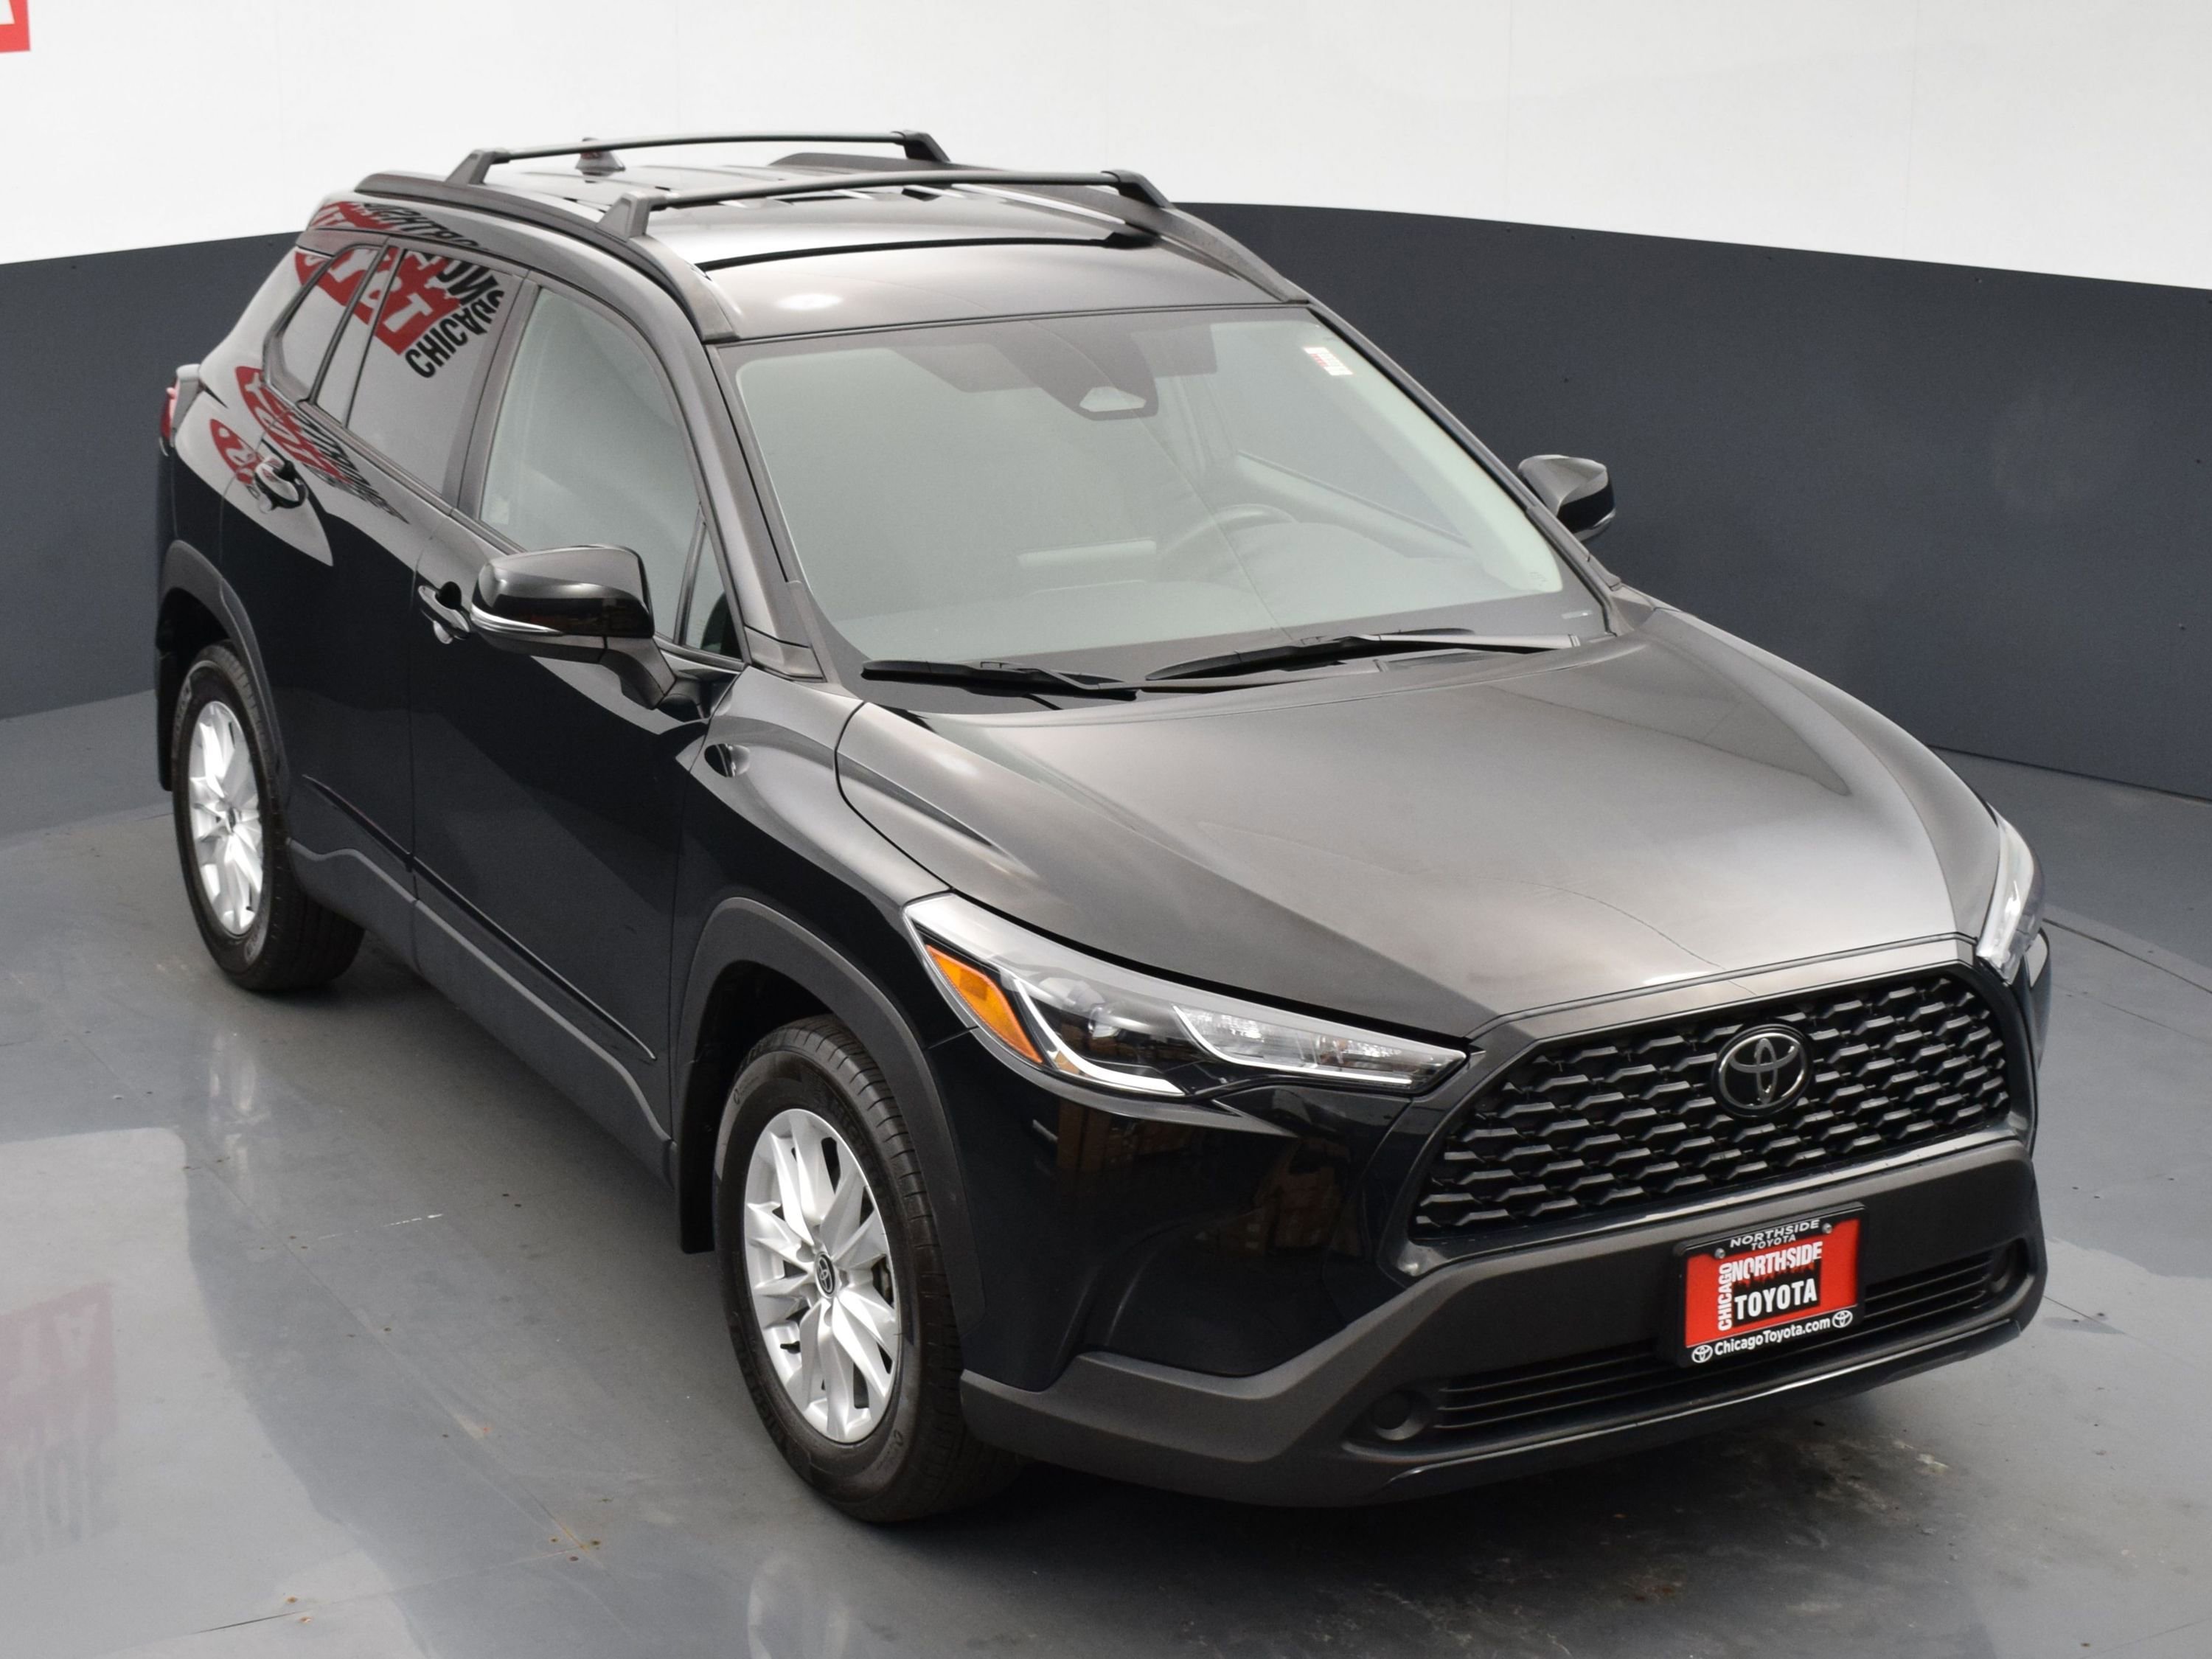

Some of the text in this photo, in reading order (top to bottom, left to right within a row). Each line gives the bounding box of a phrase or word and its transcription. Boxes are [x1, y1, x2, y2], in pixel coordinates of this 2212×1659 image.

[1729, 1219, 1820, 1248] NORTHSIDE
[1751, 1234, 1797, 1251] TOYOTA
[1731, 1241, 1823, 1283] NORTHSIDE
[1717, 1262, 1733, 1332] CHICAGO
[1733, 1278, 1818, 1321] TOYOTA
[1714, 1317, 1831, 1356] ChicagoToyota.com
